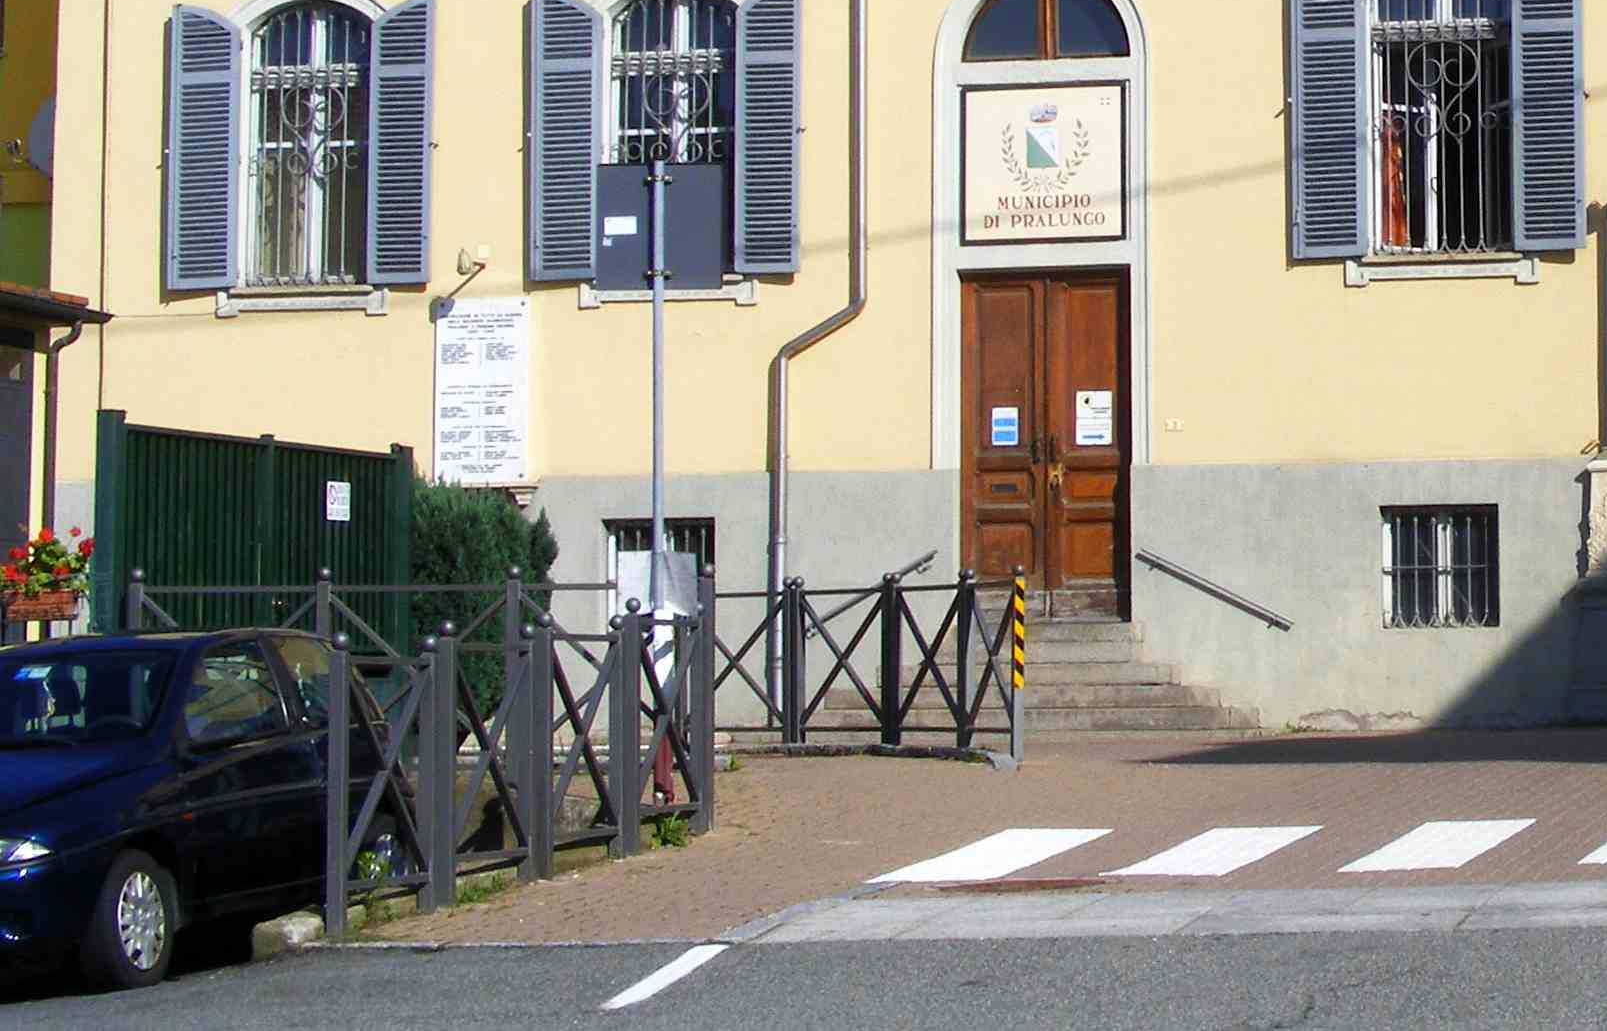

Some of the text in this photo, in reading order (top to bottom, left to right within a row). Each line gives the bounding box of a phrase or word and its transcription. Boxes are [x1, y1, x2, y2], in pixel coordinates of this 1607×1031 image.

[998, 194, 1091, 209] MUNICIPIO
[984, 212, 1105, 228] DI PRALUNGO
